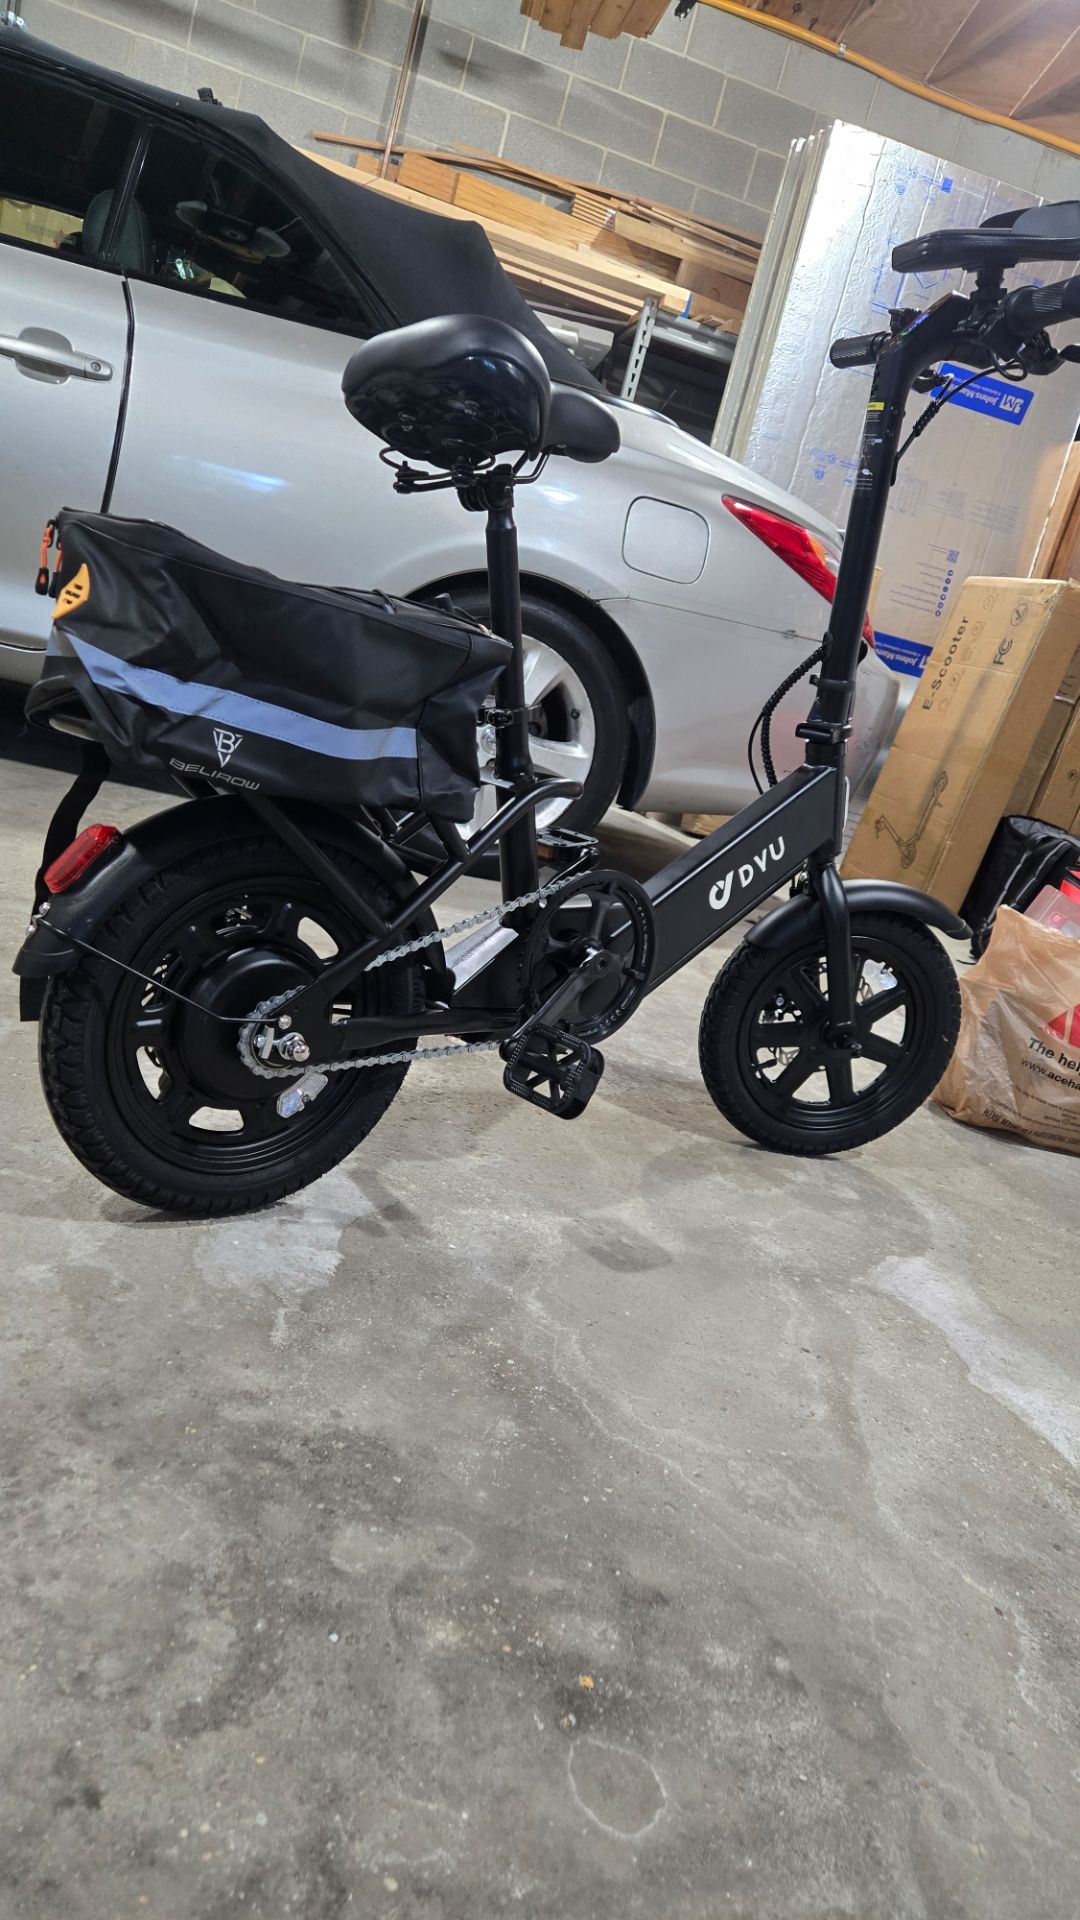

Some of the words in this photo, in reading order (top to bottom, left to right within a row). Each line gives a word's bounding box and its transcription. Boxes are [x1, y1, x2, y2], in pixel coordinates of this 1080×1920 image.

[975, 391, 1000, 406] Johns
[922, 616, 969, 710] E-Scooter
[169, 757, 261, 791] BELIROW
[738, 835, 786, 888] DYU
[1028, 1036, 1055, 1059] The
[1058, 1052, 1080, 1077] hel
